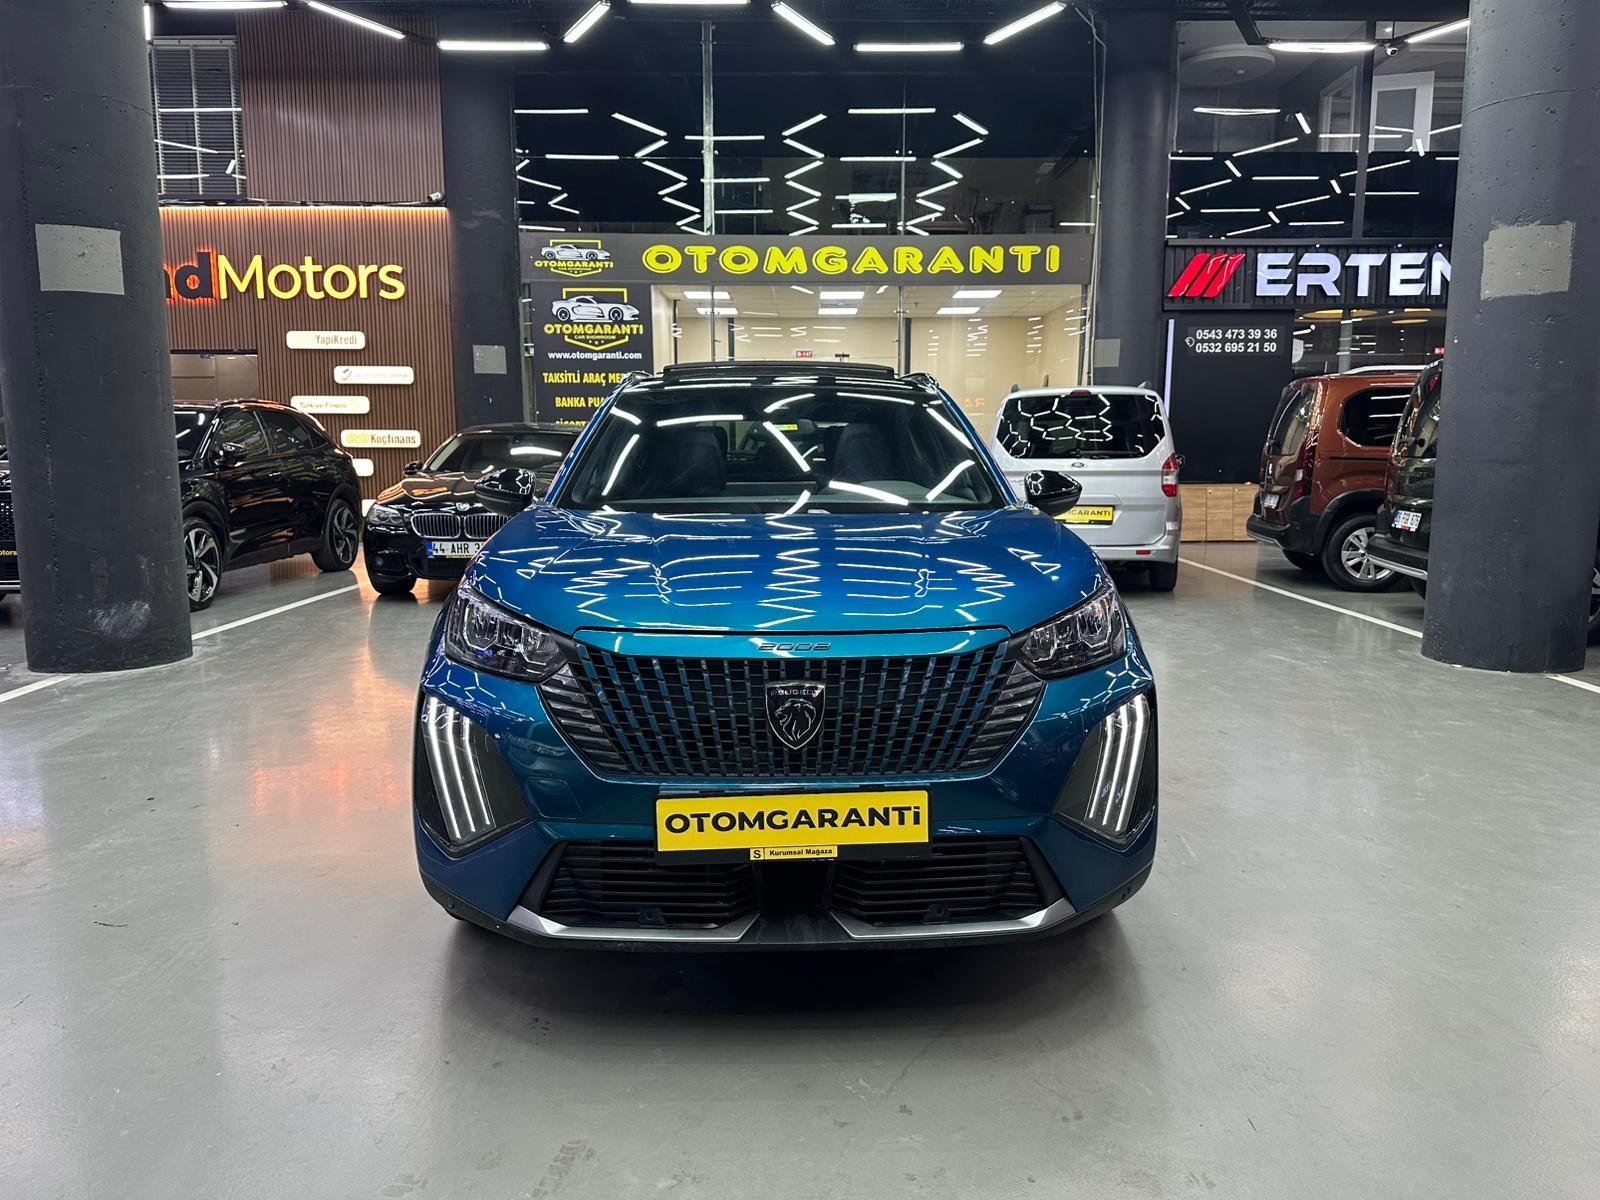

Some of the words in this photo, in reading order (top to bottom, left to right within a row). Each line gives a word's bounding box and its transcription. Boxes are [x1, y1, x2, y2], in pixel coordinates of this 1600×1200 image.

[642, 244, 1060, 275] OTOMGARANTI
[543, 323, 644, 335] OTOMGARANTI
[1196, 329, 1222, 339] 0543
[1225, 329, 1245, 339] 473
[1248, 329, 1261, 339] 39
[1264, 328, 1278, 339] 36
[1195, 343, 1222, 353] 0532
[1224, 343, 1245, 352] 695
[1247, 342, 1260, 352] 21
[1263, 342, 1277, 352] 50
[547, 351, 643, 361] www.otomgaranti.com
[543, 370, 581, 383] TAKSİTLİ
[583, 373, 606, 386] ARAÇ
[608, 373, 624, 383] ME
[555, 397, 586, 407] BANKA
[432, 543, 445, 553] 44
[450, 543, 470, 553] AHR
[758, 643, 831, 651] 2008
[753, 849, 762, 859] S
[805, 848, 833, 856] Mağaza
